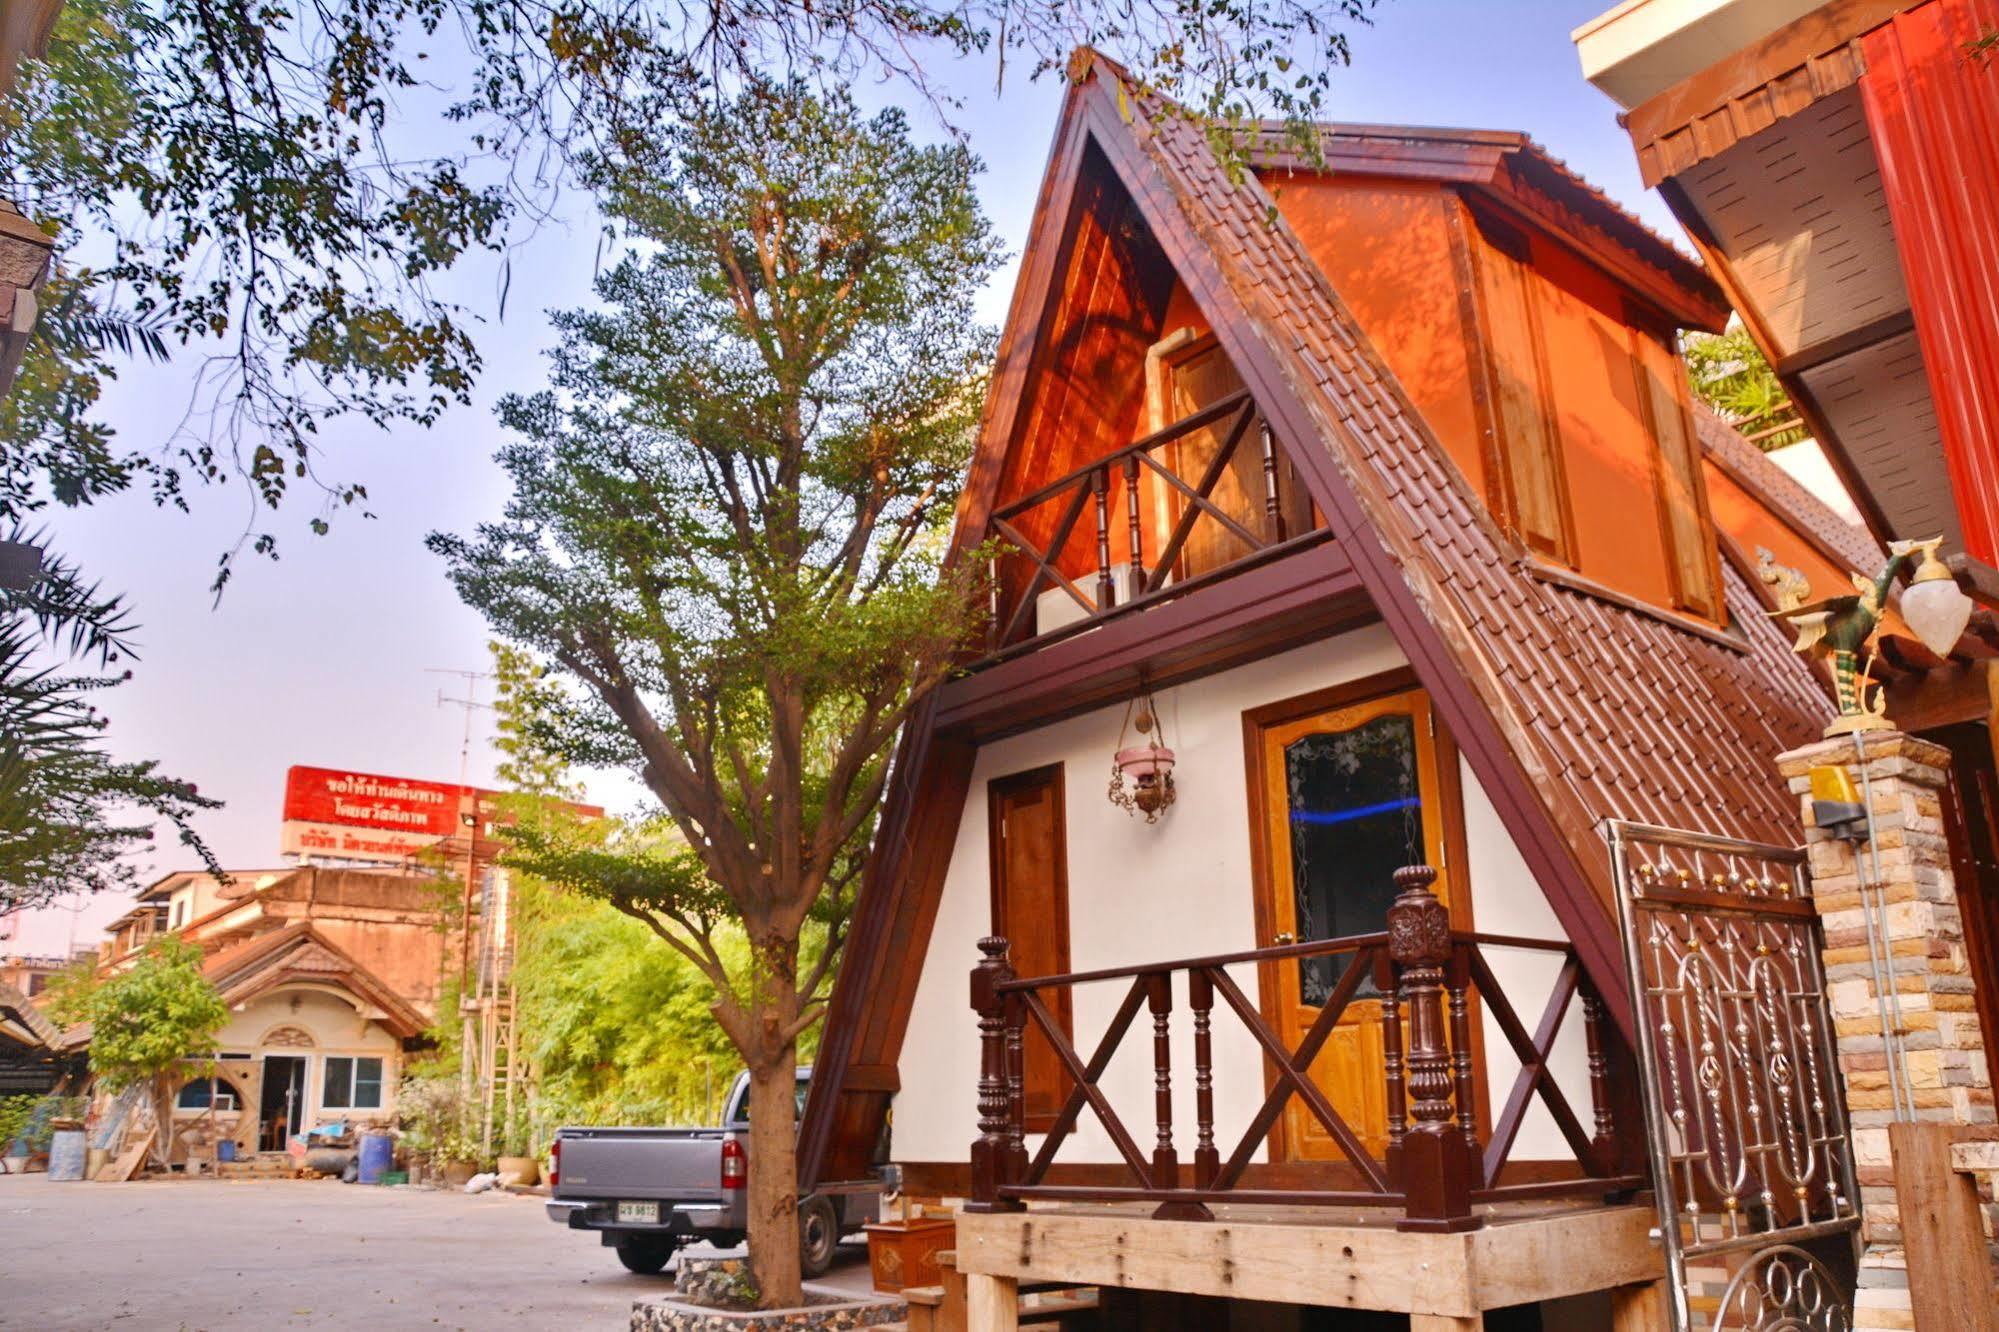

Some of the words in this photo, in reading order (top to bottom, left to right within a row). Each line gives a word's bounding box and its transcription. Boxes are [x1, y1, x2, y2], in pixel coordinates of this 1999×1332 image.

[326, 775, 444, 804] ขอให้ท่านเดินทาง
[334, 797, 428, 825] โดยสวัสดิภาพ
[300, 828, 336, 849] บริษัท
